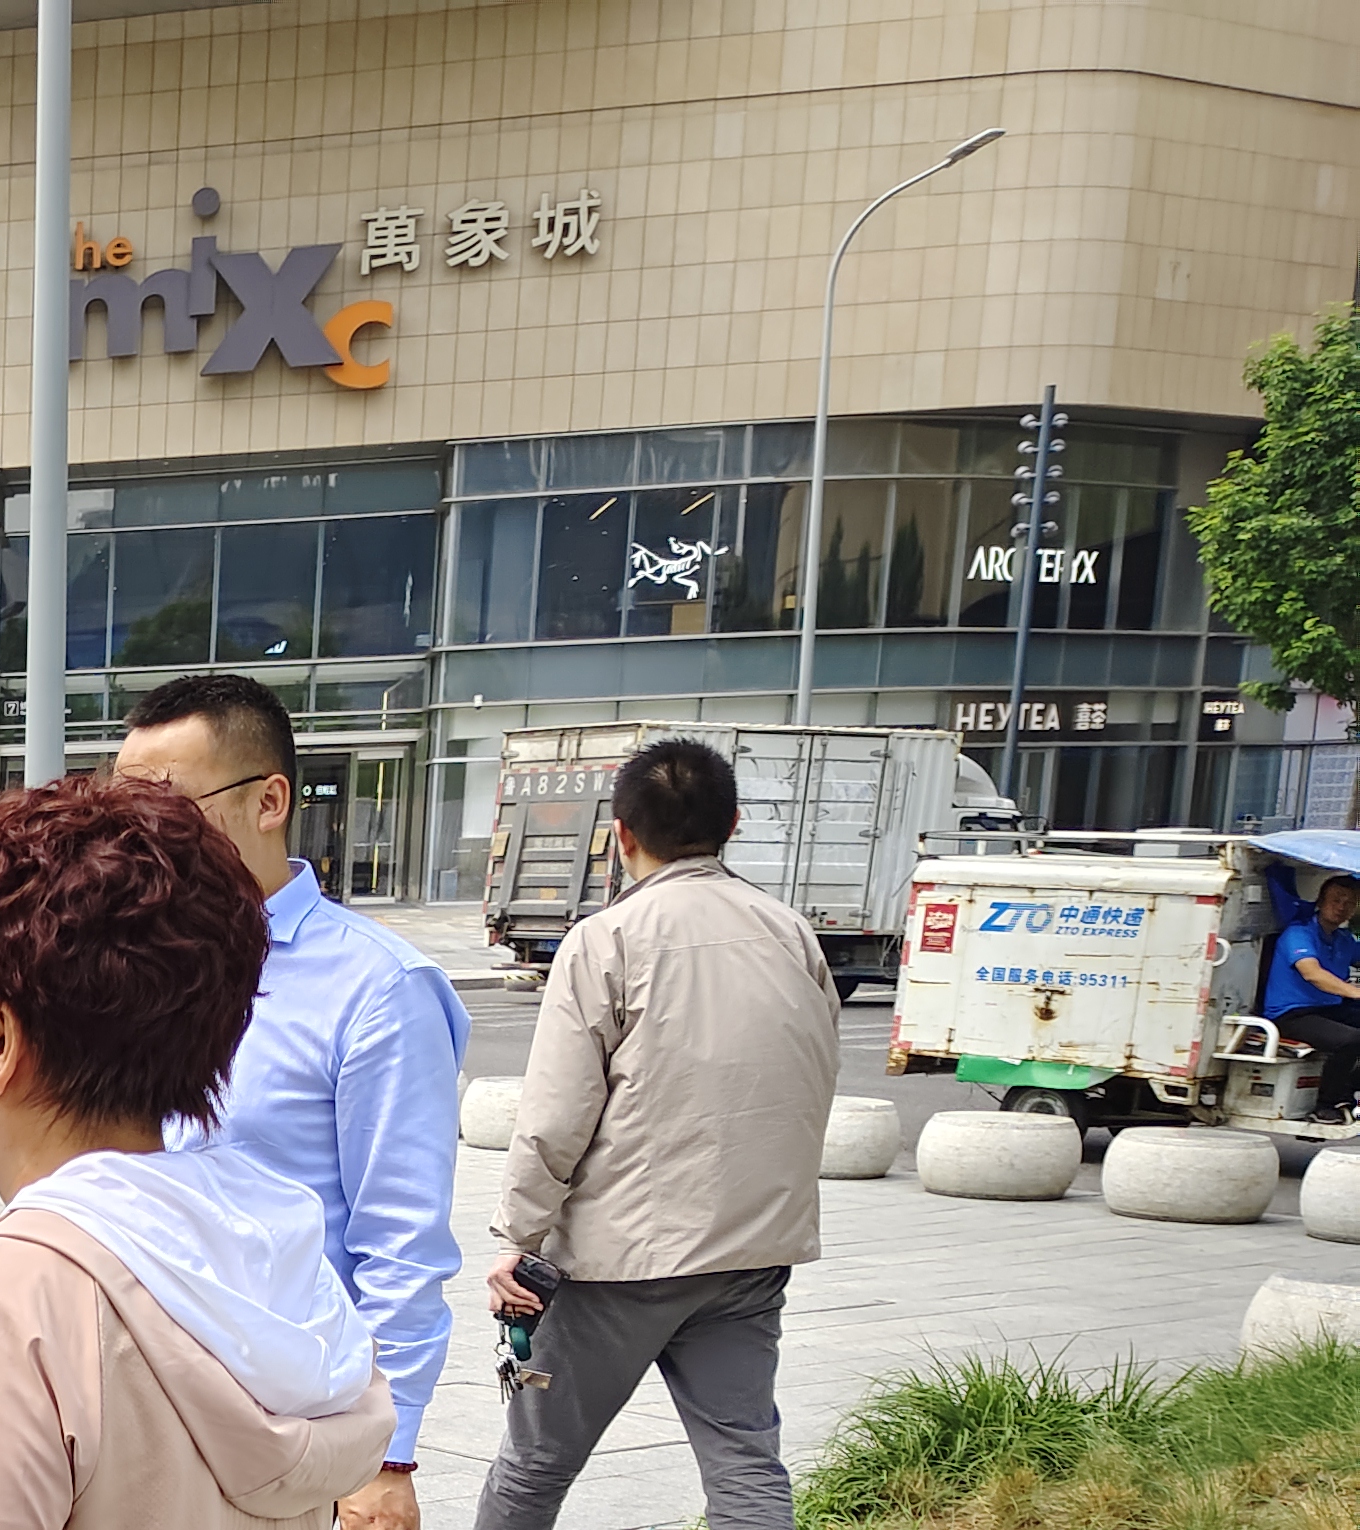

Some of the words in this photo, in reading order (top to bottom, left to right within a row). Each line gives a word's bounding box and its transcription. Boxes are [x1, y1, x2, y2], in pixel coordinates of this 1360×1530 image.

[73, 221, 133, 271] he
[359, 188, 603, 276] 萬象城
[955, 702, 1060, 731] HEYTEA
[979, 901, 1055, 933] ZTO
[1059, 905, 1146, 926] 中通快递
[1055, 926, 1080, 936] ZTO
[1081, 927, 1140, 938] EXPRESS
